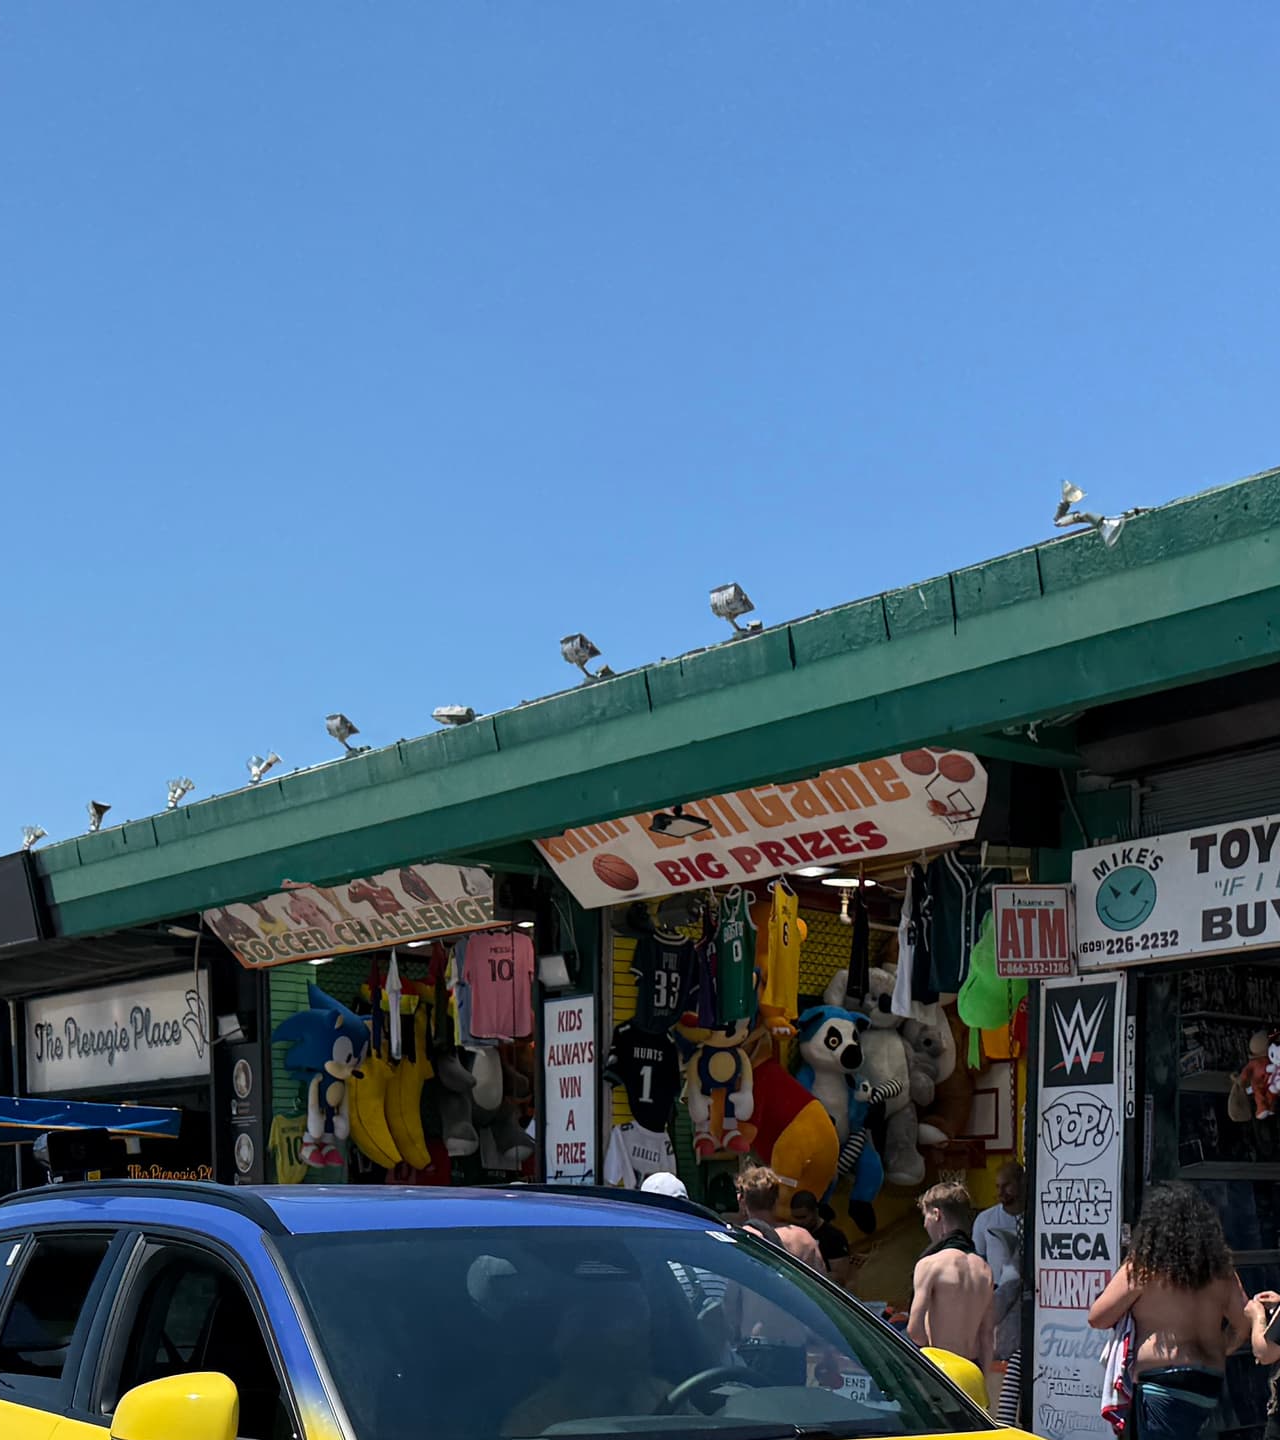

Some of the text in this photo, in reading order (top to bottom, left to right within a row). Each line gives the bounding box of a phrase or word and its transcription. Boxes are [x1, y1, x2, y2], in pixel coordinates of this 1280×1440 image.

[736, 757, 912, 829] Game
[654, 820, 889, 887] BIG PRIZES
[1092, 847, 1164, 880] MIKE'S
[235, 896, 495, 964] SOCCER CHALLENGE
[1000, 908, 1067, 959] ATM
[1106, 929, 1179, 956] 226-2232
[488, 958, 514, 982] 10
[557, 1008, 583, 1033] KIDS
[34, 1005, 182, 1067] The Pierogie Place
[547, 1041, 594, 1067] ALWAYS
[559, 1075, 582, 1099] WIN
[565, 1109, 576, 1132] A
[1041, 1103, 1113, 1152] POP!
[556, 1142, 587, 1165] PRIZE
[1040, 1178, 1113, 1203] STAR
[1041, 1200, 1113, 1225] WARS
[1040, 1232, 1111, 1261] NECA
